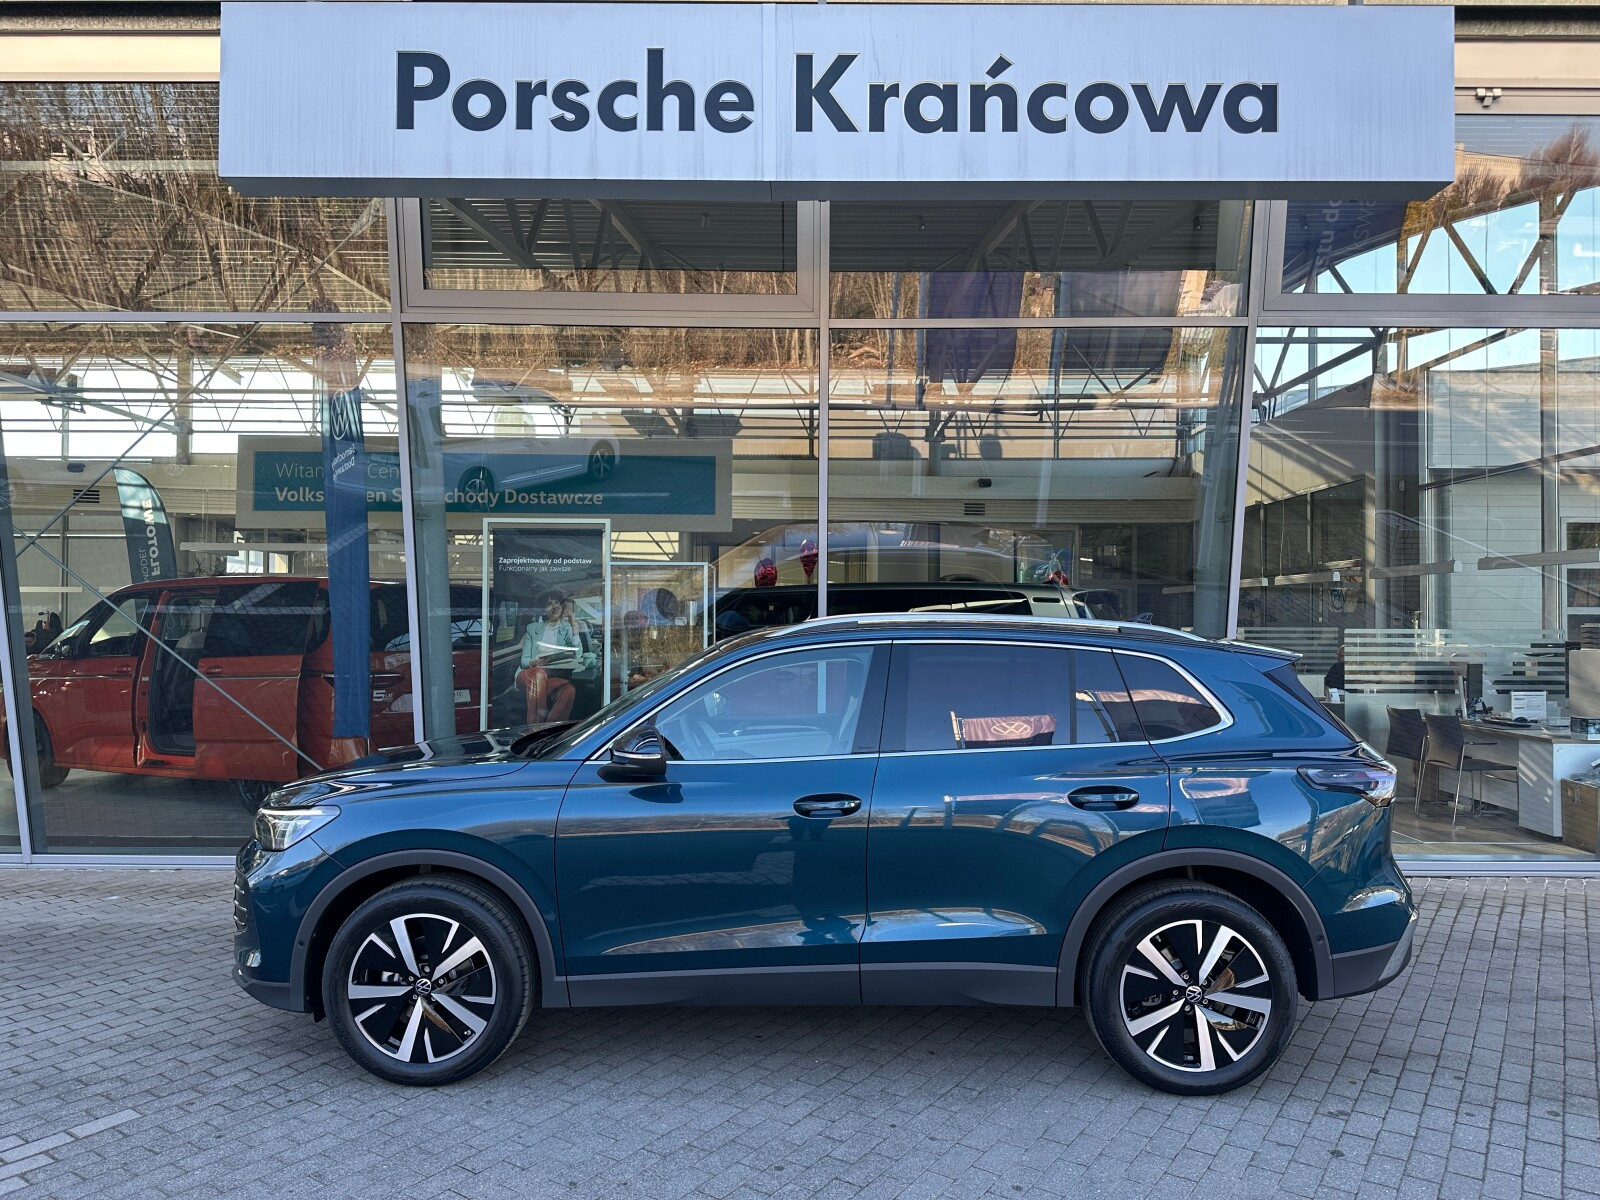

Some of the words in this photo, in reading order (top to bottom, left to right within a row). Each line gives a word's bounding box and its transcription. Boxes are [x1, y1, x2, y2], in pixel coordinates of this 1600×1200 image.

[396, 48, 754, 133] Porsche
[795, 53, 1279, 134] Krańcowa
[275, 486, 386, 502] Volksen
[393, 488, 499, 507] Schody
[504, 489, 603, 505] Dostawcze
[499, 557, 552, 566] Zaprojektowany
[563, 557, 592, 566] podstaw
[499, 565, 538, 573] Funkcjonalny
[539, 565, 548, 573] jak
